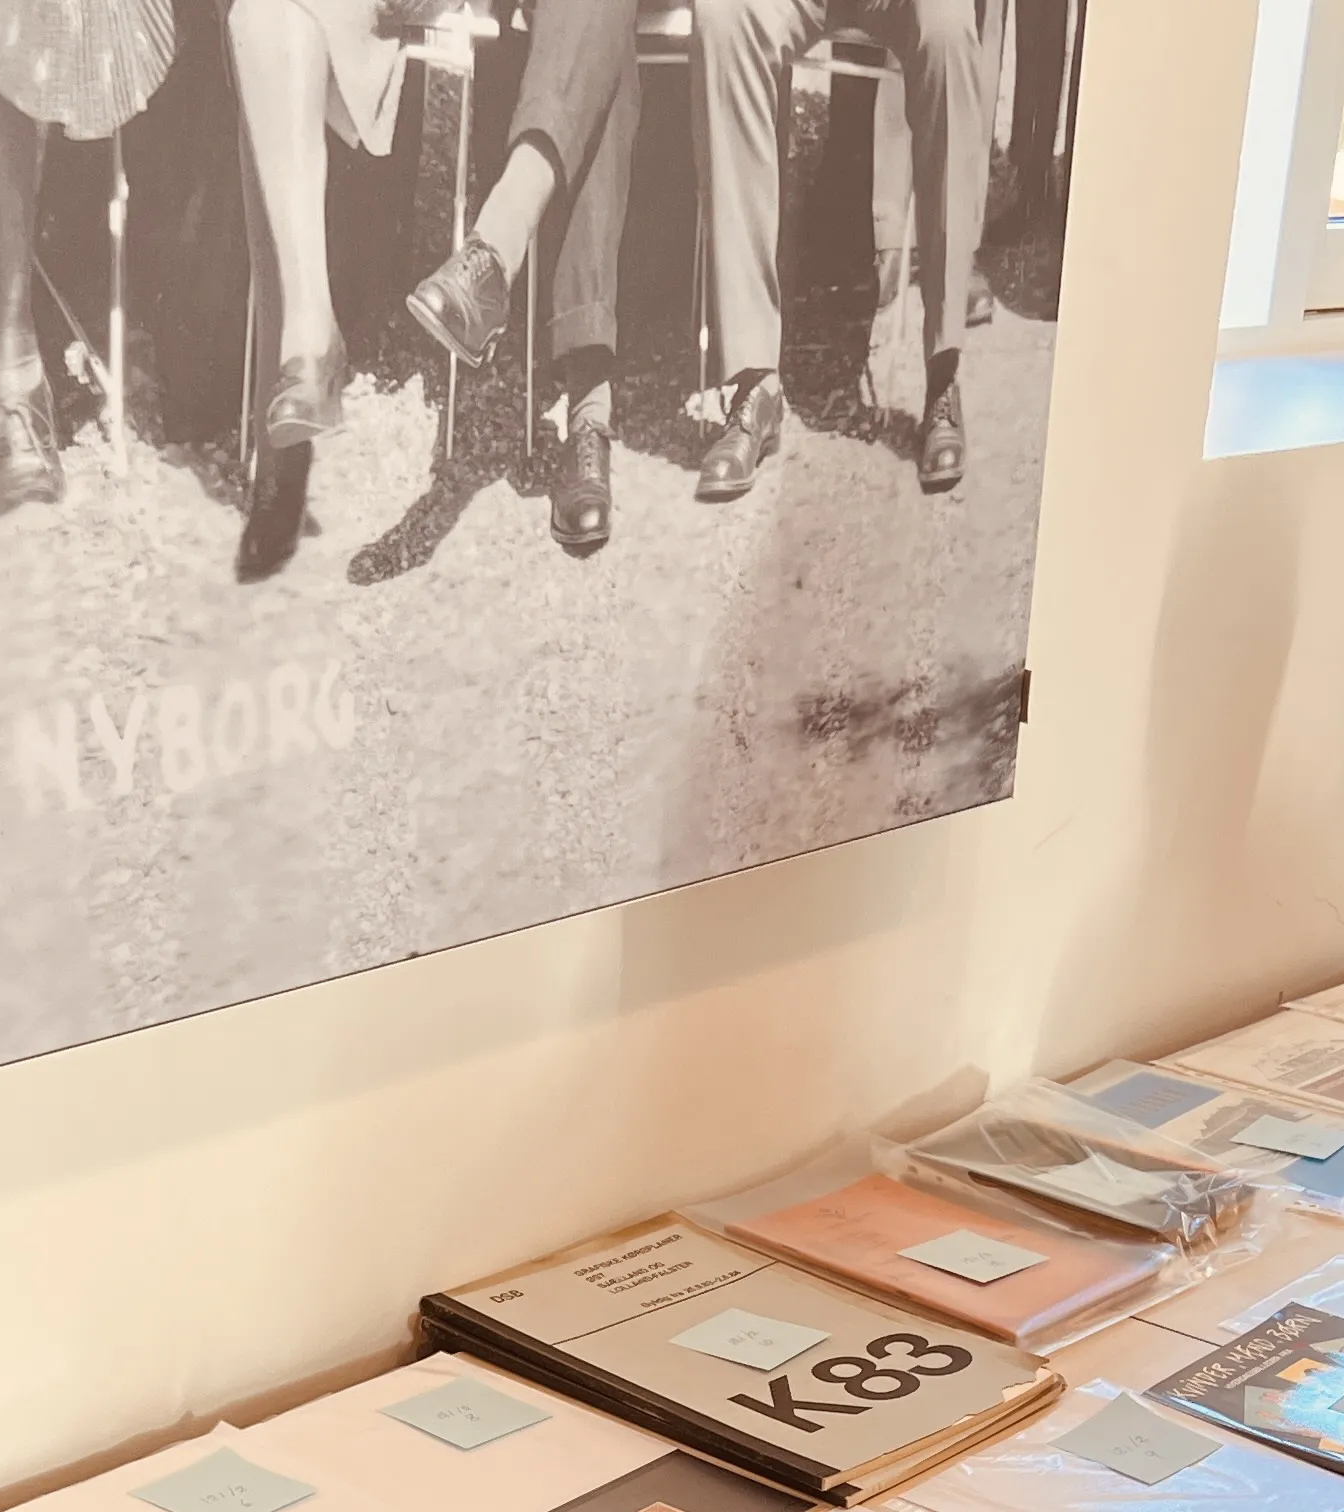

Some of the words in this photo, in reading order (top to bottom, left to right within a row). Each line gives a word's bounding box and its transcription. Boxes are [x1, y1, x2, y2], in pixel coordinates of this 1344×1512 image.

[12, 660, 357, 814] NYBORG
[489, 1289, 524, 1304] DSB
[1266, 1313, 1322, 1342] BØRN
[726, 1331, 973, 1433] K83
